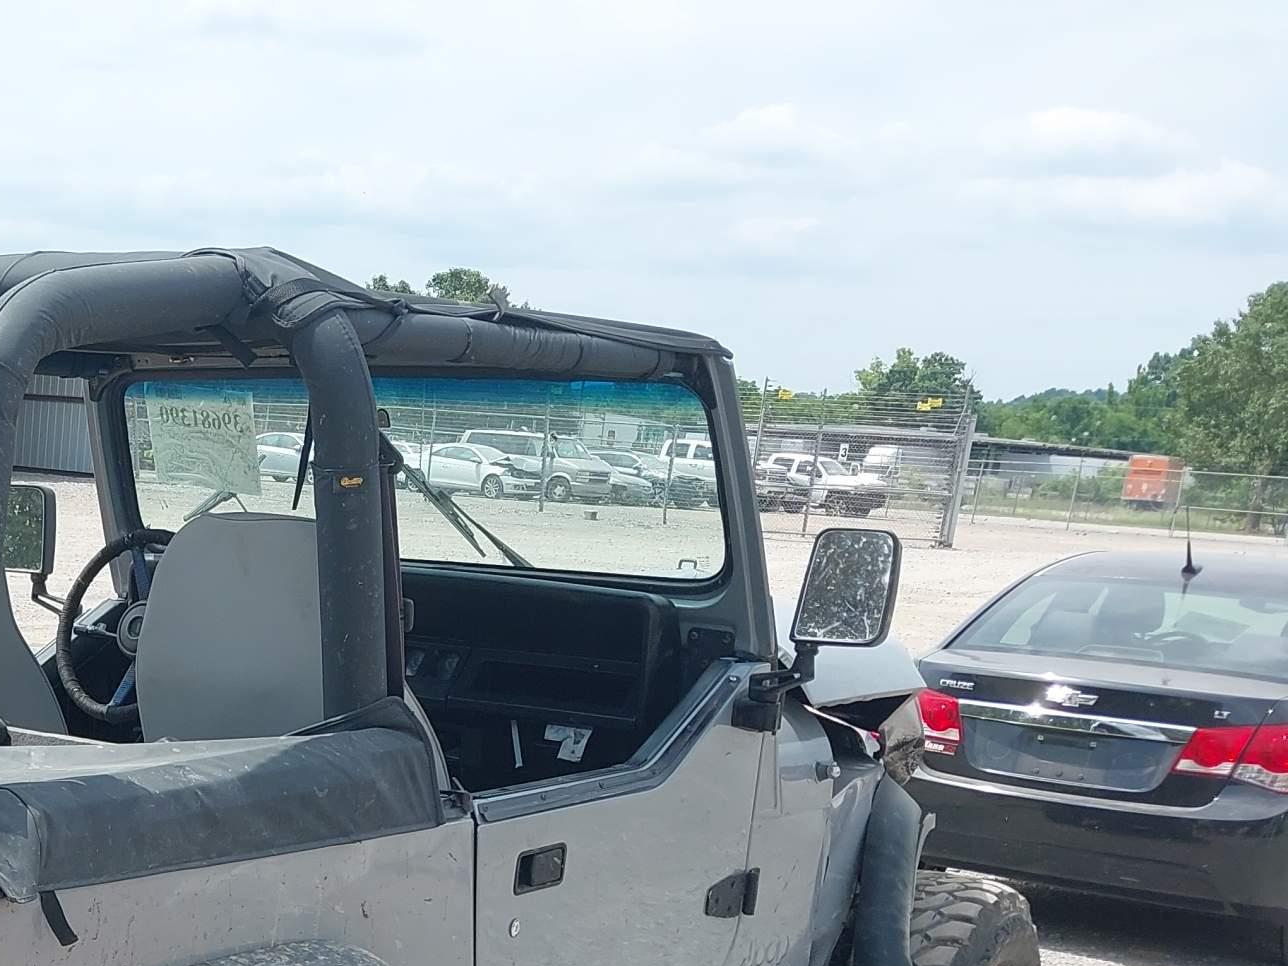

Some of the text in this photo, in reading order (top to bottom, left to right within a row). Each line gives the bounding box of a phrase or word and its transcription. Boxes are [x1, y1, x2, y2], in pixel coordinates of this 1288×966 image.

[840, 447, 848, 458] 3
[939, 678, 975, 691] CRUZE
[1213, 710, 1232, 719] LT
